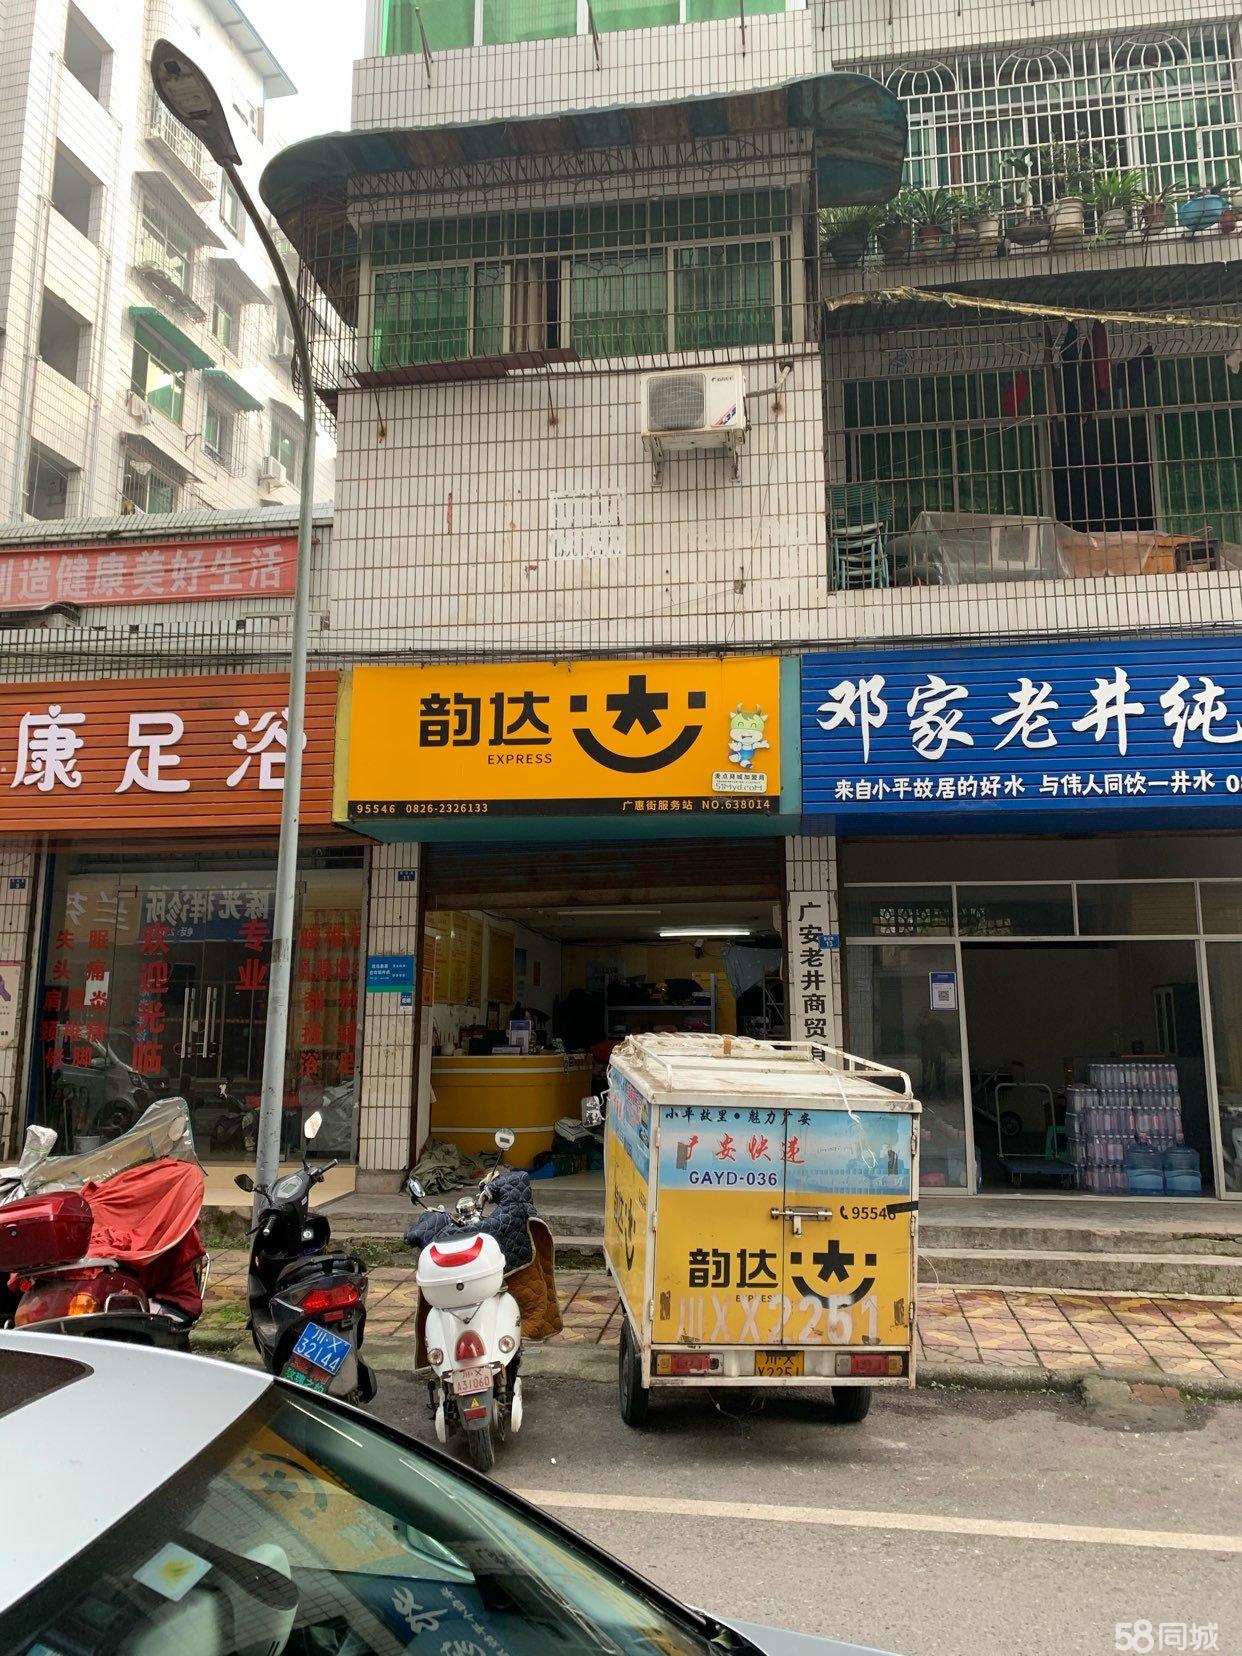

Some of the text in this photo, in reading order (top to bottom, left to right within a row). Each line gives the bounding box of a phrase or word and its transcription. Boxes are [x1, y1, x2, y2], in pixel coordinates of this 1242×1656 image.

[419, 690, 553, 747] 韵达
[487, 753, 553, 765] EXPRESS
[834, 770, 1242, 801] 来自小平故居的好水 与伟人同饮一井水 0
[356, 803, 489, 814] 95546 0826-2326133
[622, 799, 770, 811] 广惠街服务站 NO.638014
[689, 1171, 778, 1186] GAYD-036
[852, 1207, 896, 1220] 95546
[689, 1248, 778, 1288] 韵达
[297, 1338, 341, 1371] 32144
